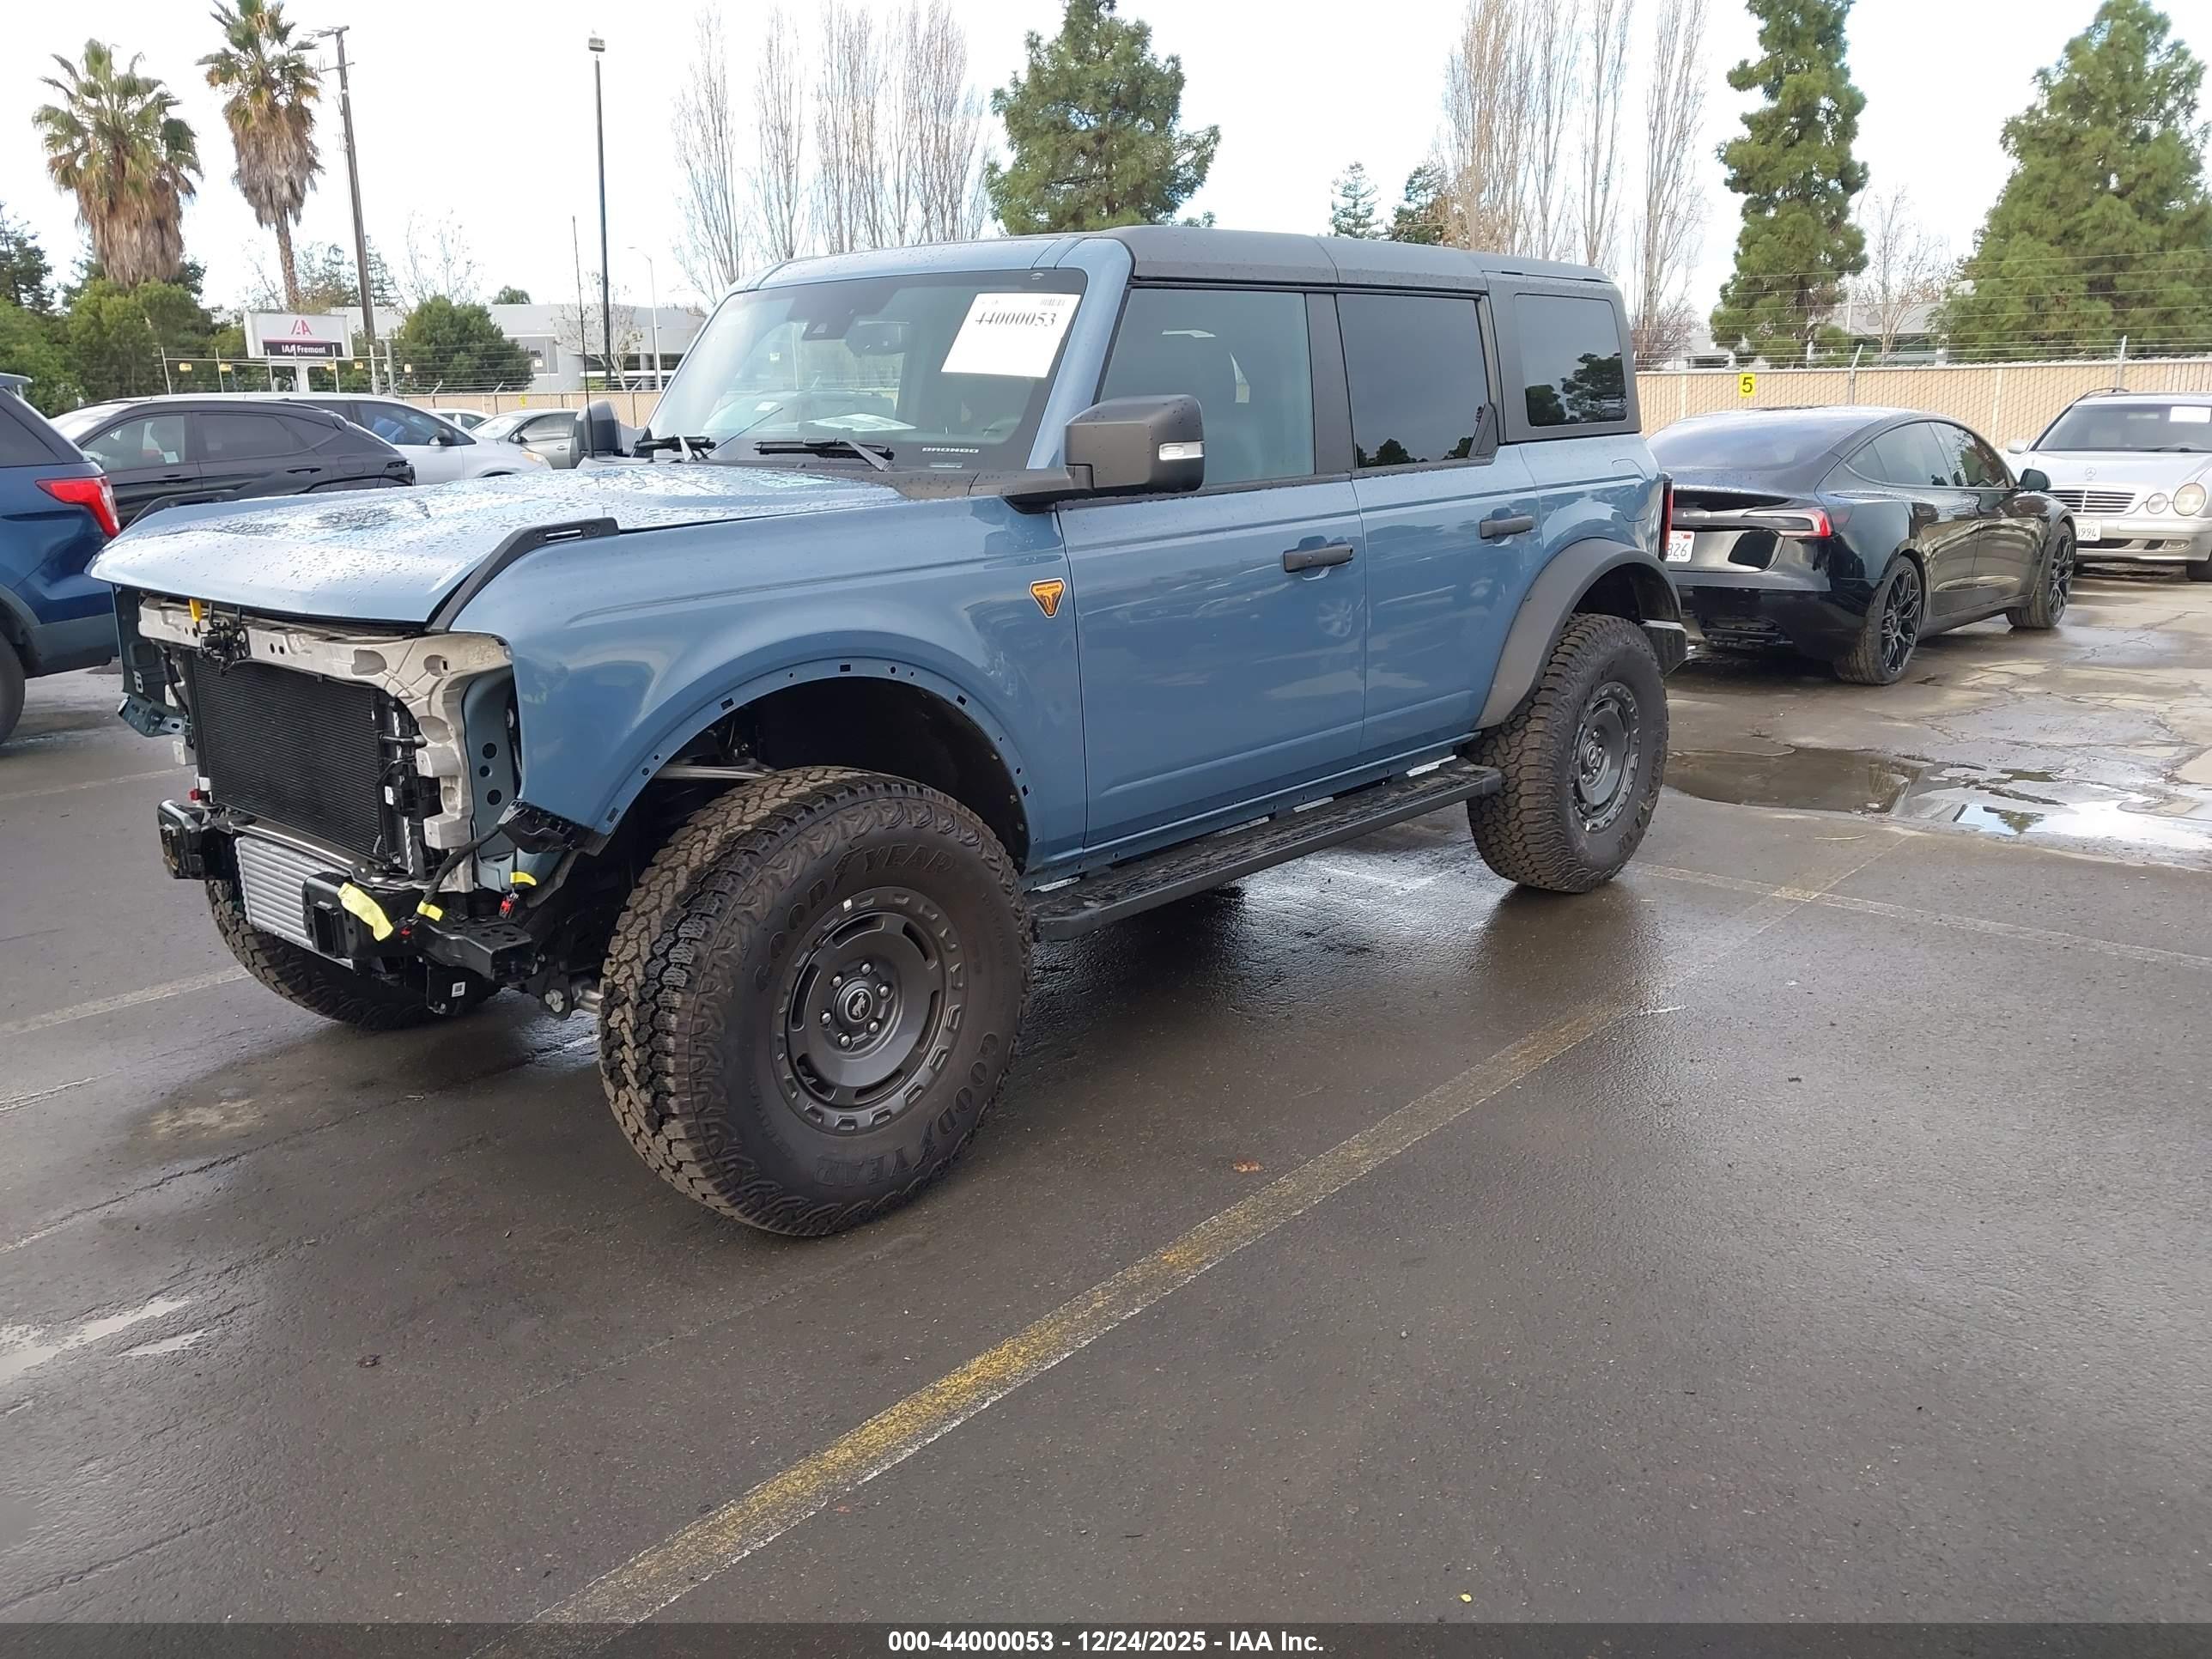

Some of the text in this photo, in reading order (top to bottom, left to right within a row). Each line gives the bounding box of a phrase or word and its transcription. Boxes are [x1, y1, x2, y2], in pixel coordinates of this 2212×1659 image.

[975, 311, 1057, 327] 44000053
[297, 344, 326, 354] Fremont
[1741, 376, 1753, 393] 5
